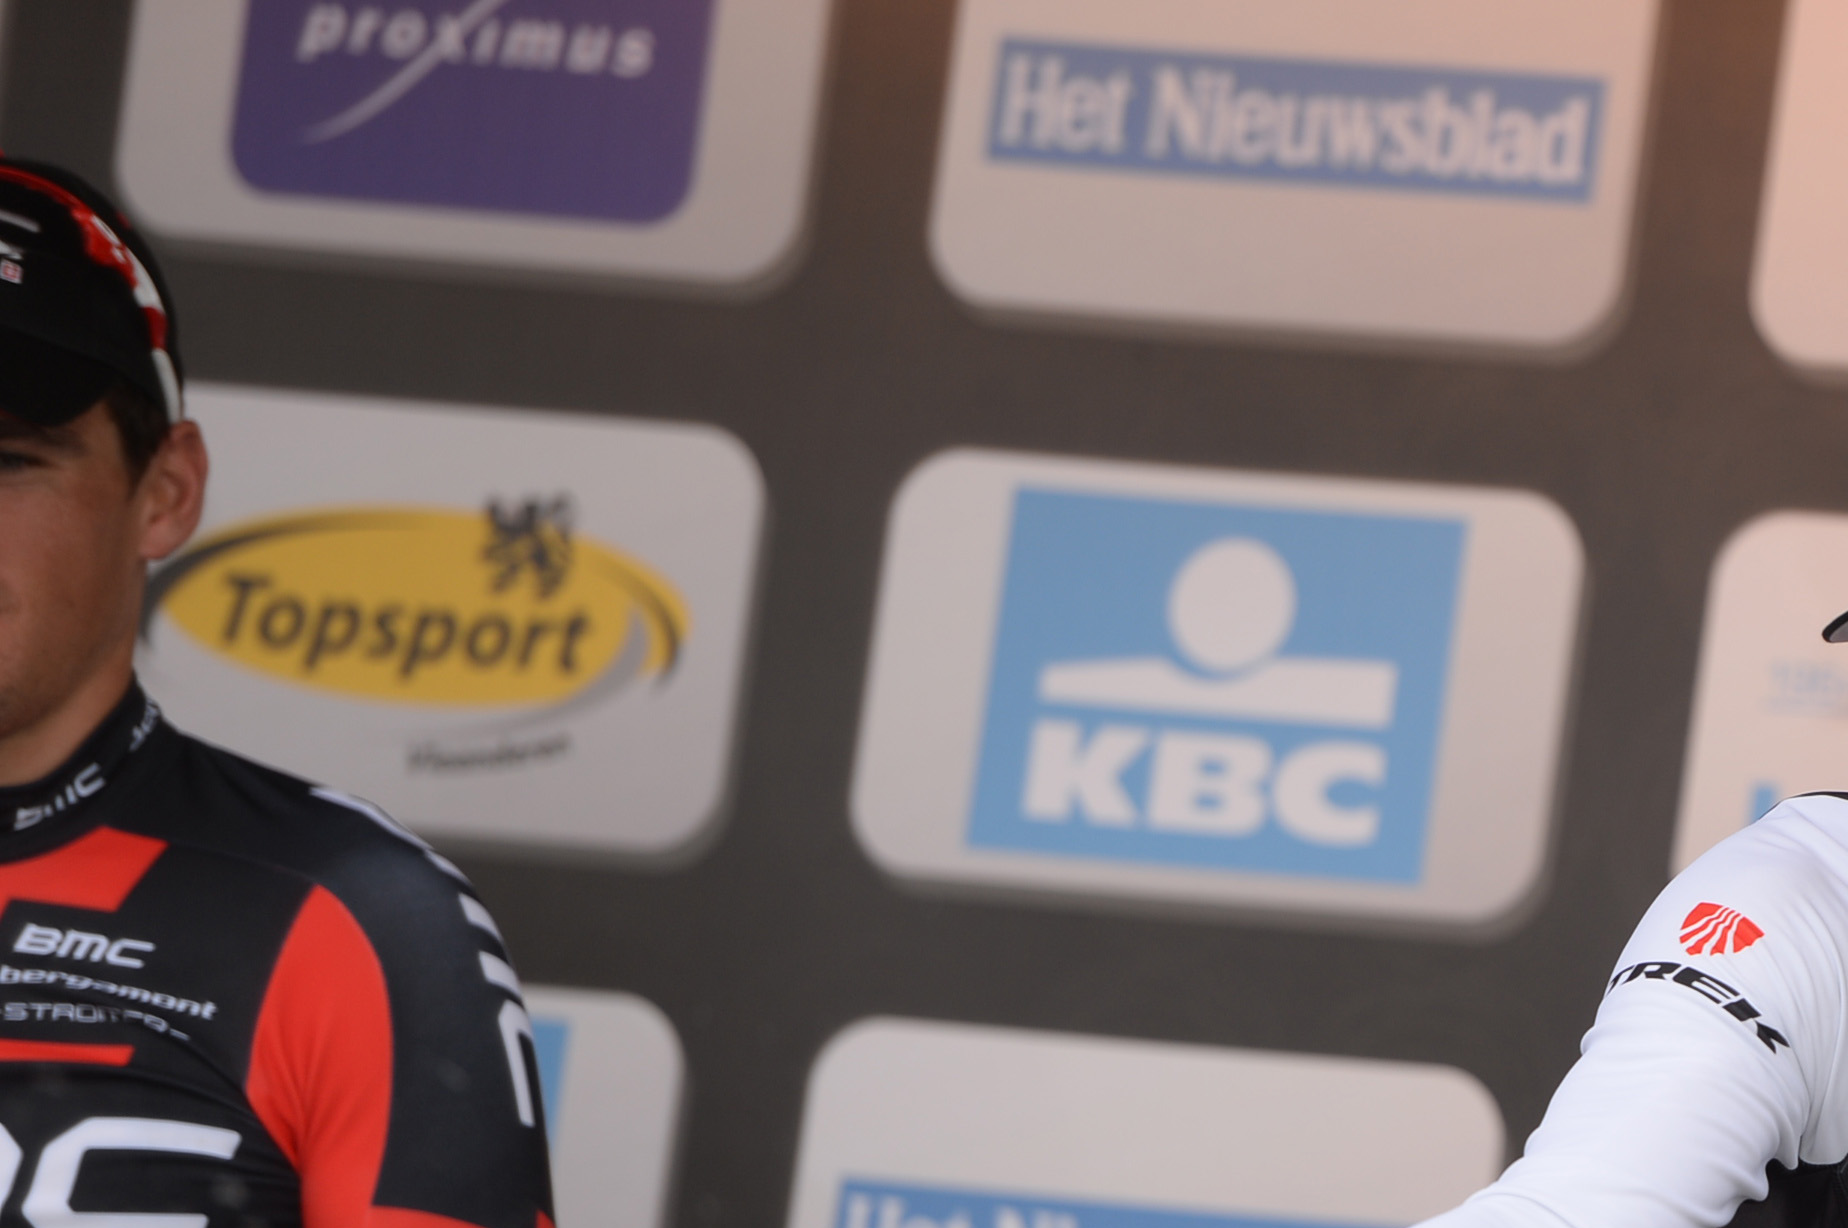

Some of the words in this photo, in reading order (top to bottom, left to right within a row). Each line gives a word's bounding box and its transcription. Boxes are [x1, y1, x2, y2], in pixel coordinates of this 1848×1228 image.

[296, 3, 654, 79] proximus
[1001, 54, 1134, 156] Het
[1149, 64, 1594, 184] Nieuwsblad
[221, 569, 590, 681] Topsport
[1022, 719, 1388, 847] KBC
[13, 922, 156, 969] BMC
[1604, 961, 1790, 1055] TREK
